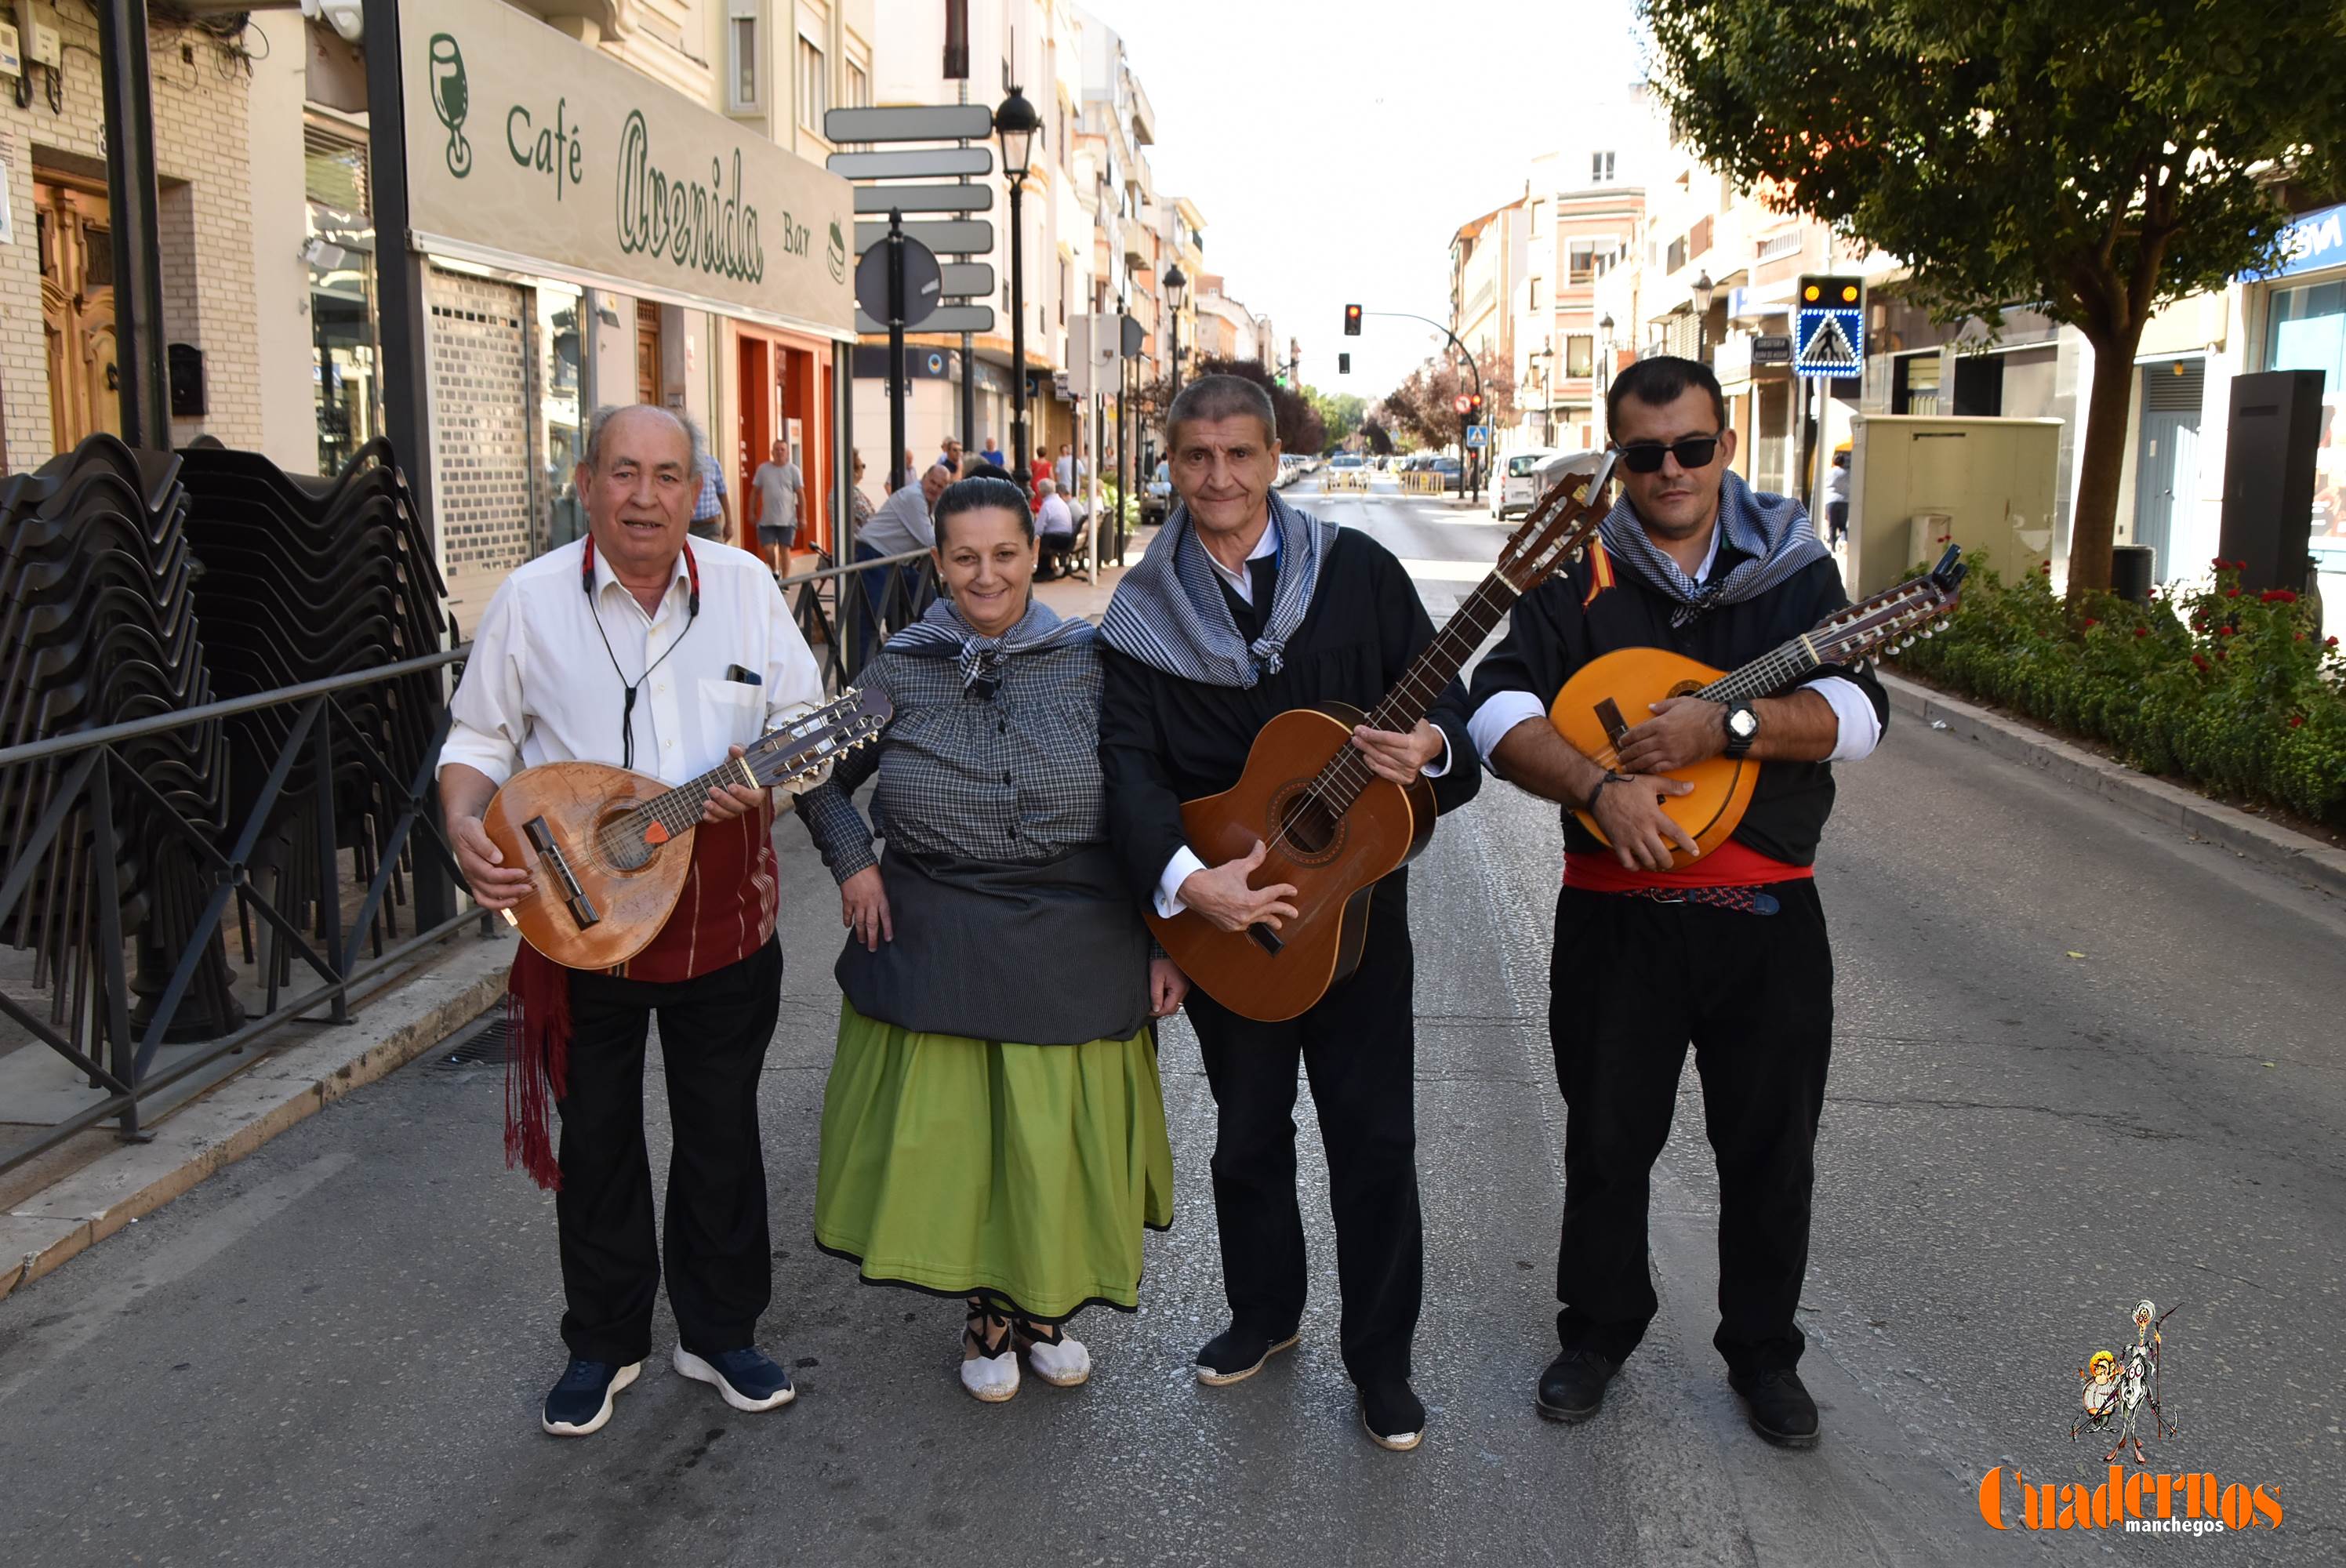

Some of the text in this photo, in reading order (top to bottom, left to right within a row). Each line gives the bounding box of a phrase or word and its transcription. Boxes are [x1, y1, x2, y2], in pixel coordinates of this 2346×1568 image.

[507, 97, 811, 284] Café Avenida Bar
